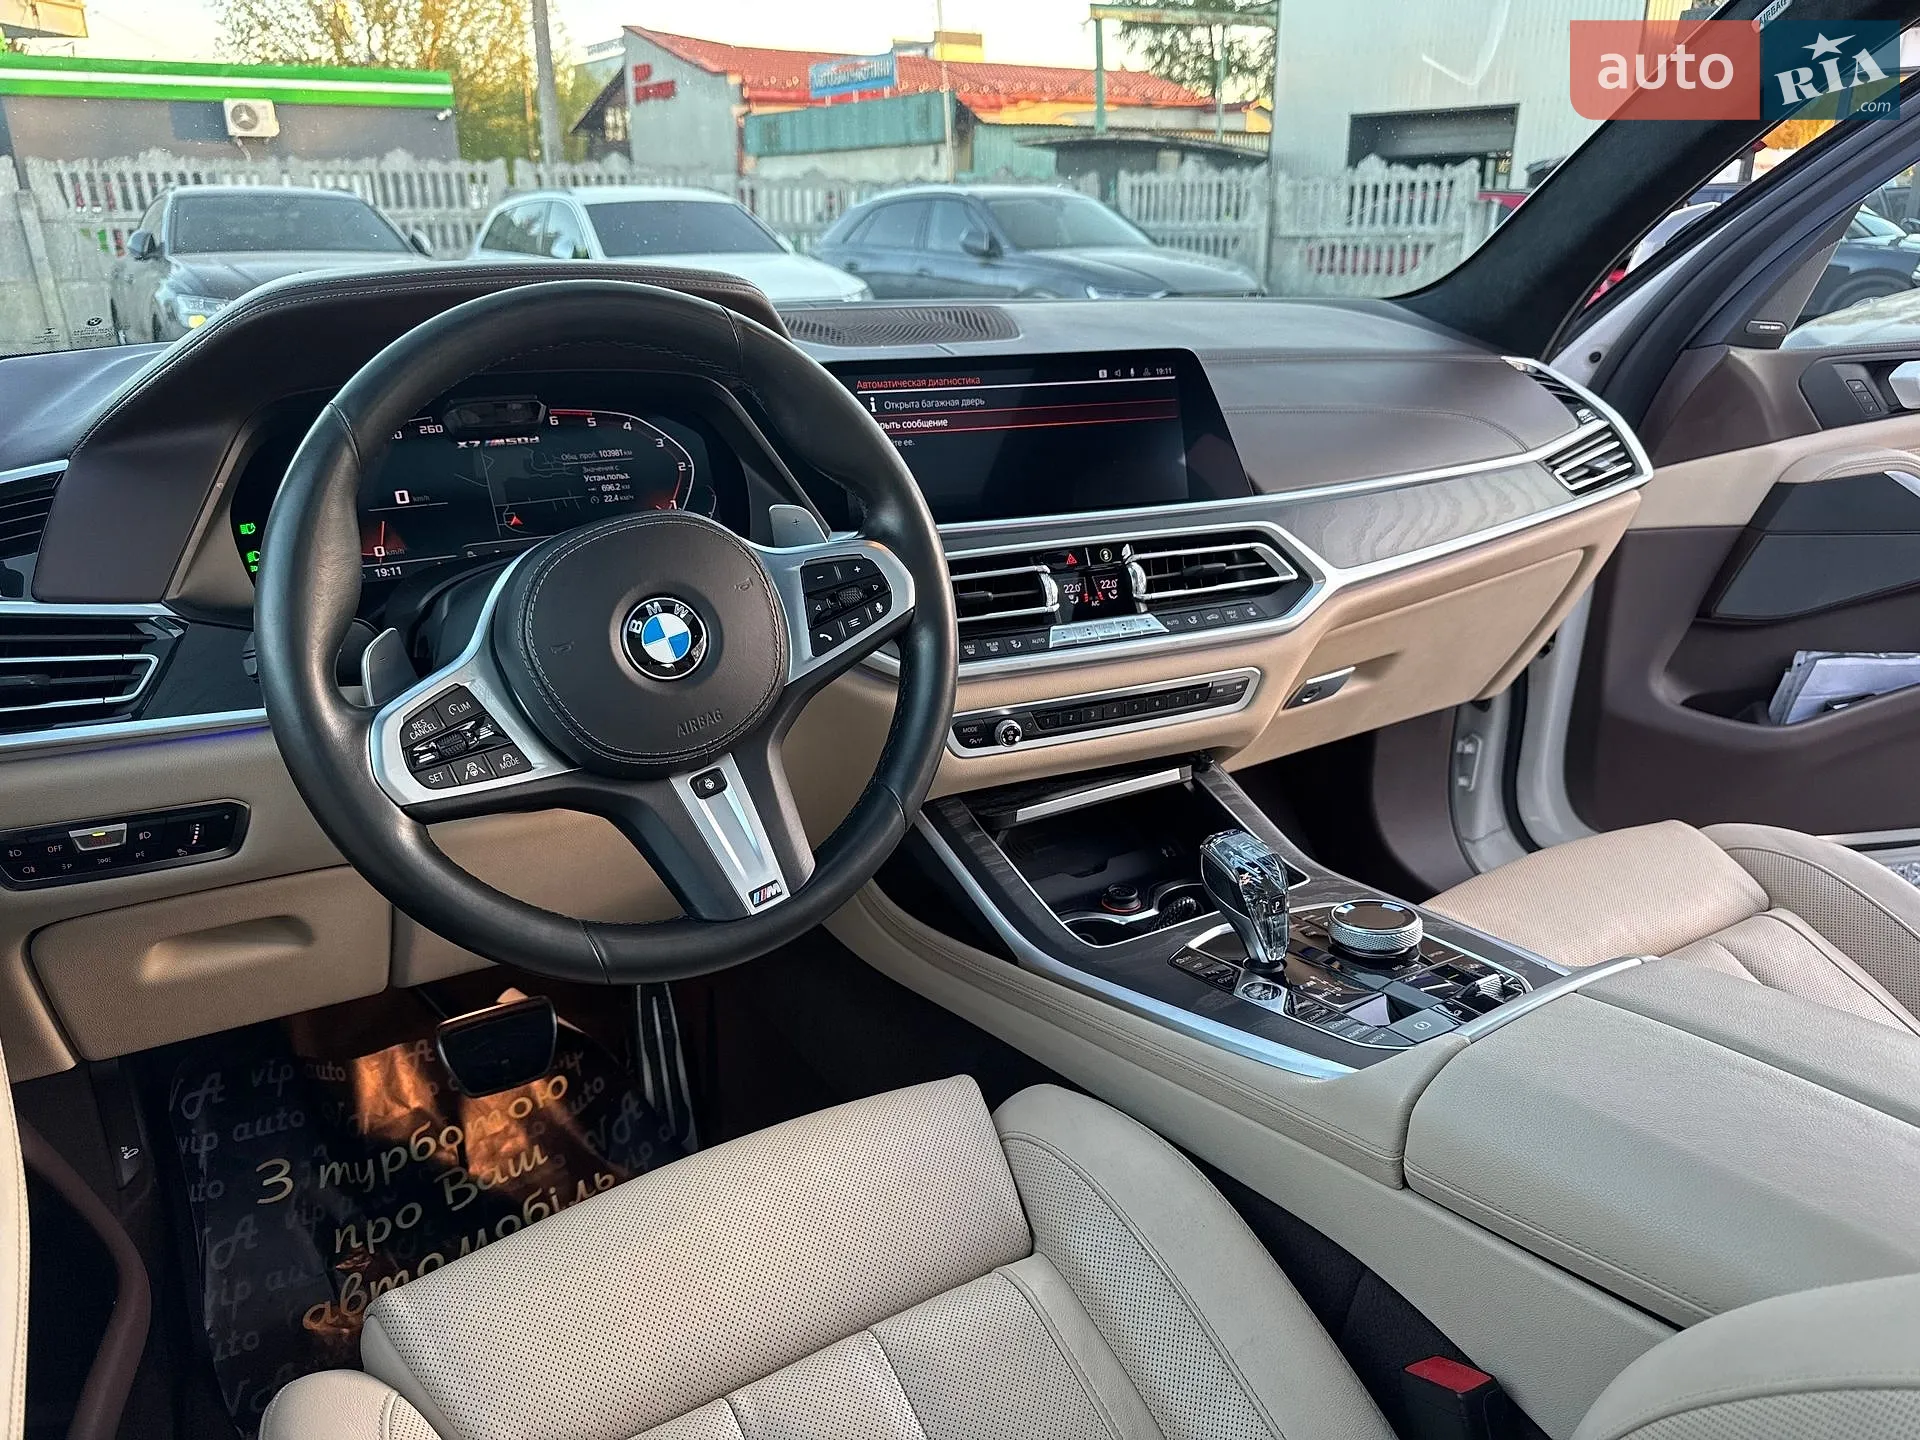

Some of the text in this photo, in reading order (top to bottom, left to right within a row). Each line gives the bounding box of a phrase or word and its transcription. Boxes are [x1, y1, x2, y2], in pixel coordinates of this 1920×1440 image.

[856, 376, 981, 390] Автоматическая диагностика
[884, 397, 985, 410] Открыта багажная дверь
[549, 416, 559, 426] 6
[587, 417, 597, 427] 5
[623, 421, 632, 431] 4
[902, 418, 949, 428] сообщение
[419, 424, 444, 435] 260
[457, 440, 481, 449] X7
[655, 438, 664, 448] 3
[599, 449, 624, 458] 103981
[678, 461, 687, 471] 2
[394, 490, 410, 504] 0
[603, 494, 620, 503] 22.4
[373, 546, 386, 558] 0
[374, 566, 402, 579] 19:11
[629, 602, 688, 633] BMW
[459, 701, 472, 713] LIM
[411, 719, 427, 731] RES
[677, 709, 723, 738] AIRBAG
[409, 723, 438, 740] CANCEL
[500, 757, 520, 770] MODE
[428, 772, 444, 784] SET
[47, 845, 63, 853] OFF
[233, 1107, 306, 1142] auto
[319, 1073, 569, 1193] турботою
[334, 1144, 550, 1255] про Ваш
